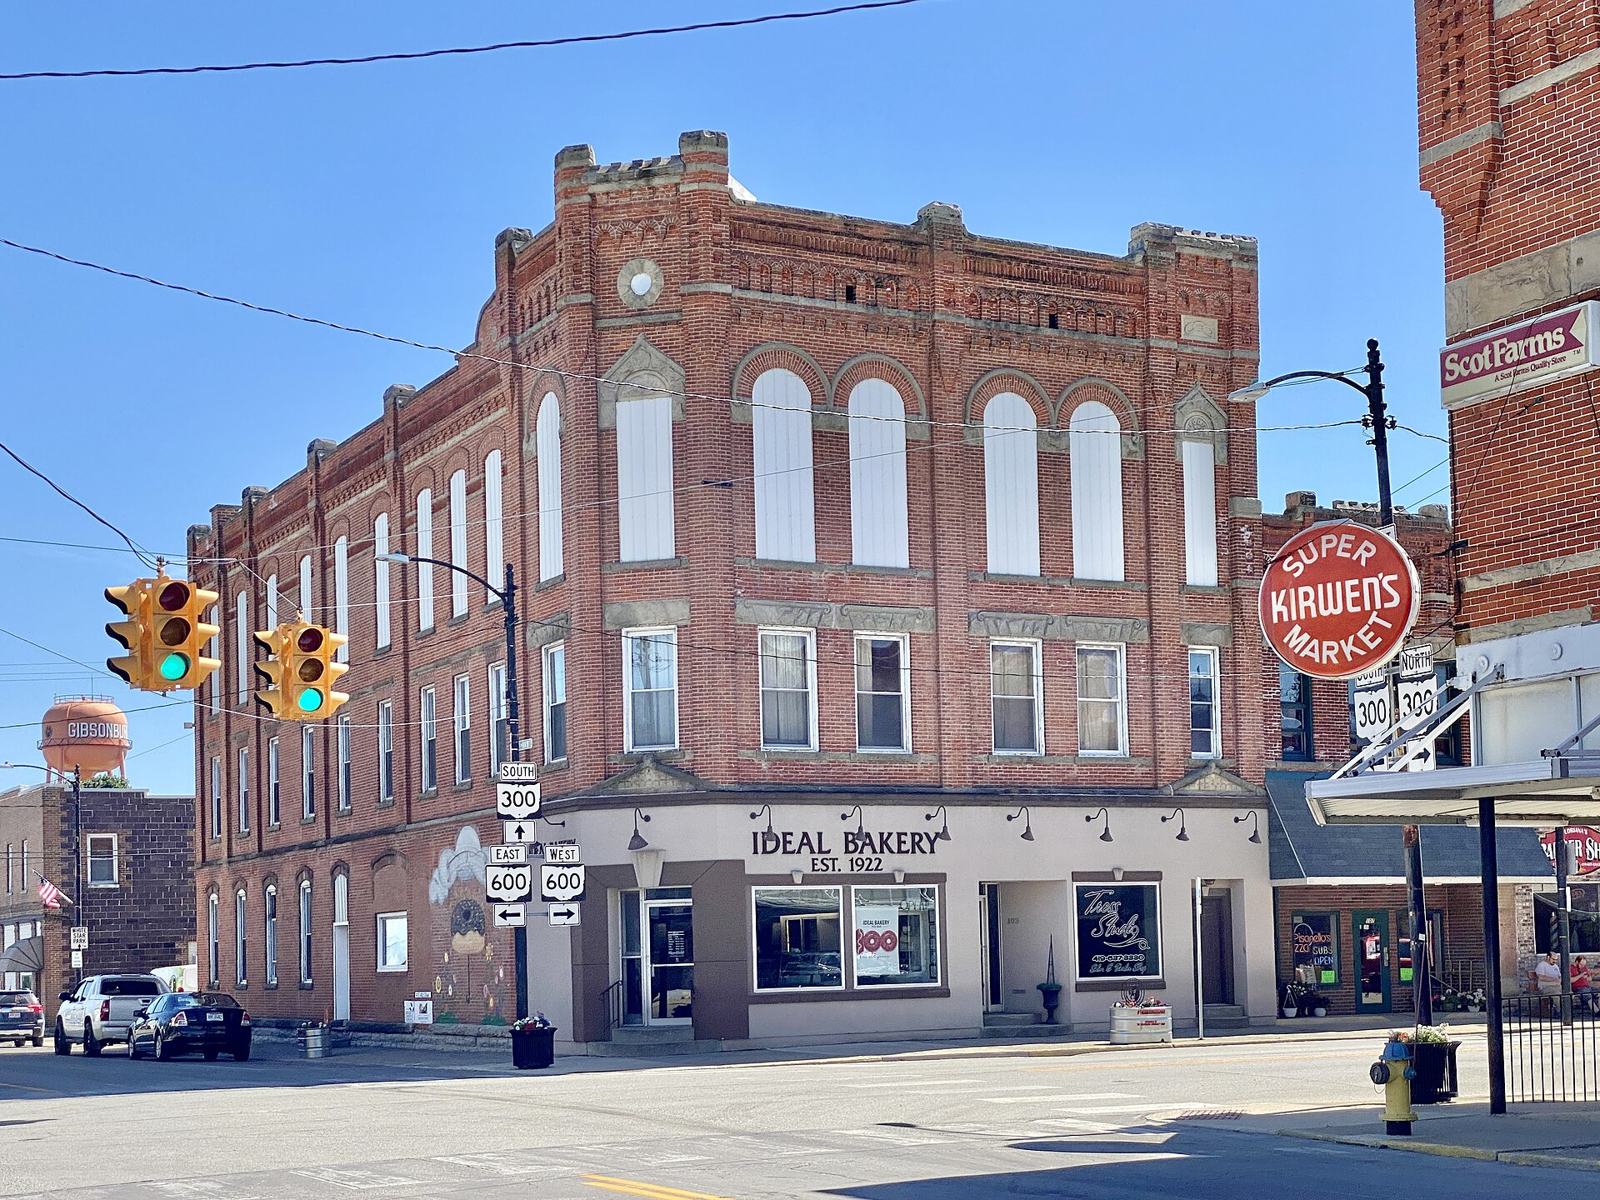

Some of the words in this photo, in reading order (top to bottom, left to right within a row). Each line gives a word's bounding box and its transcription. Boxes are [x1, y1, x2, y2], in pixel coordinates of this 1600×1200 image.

[1500, 372, 1513, 381] Scot
[1513, 367, 1530, 377] Farms
[1530, 359, 1552, 372] Quality
[1551, 356, 1567, 365] Store
[1282, 533, 1377, 578] SUPER
[1271, 572, 1400, 623] KIRWEN'S
[1283, 611, 1392, 665] MARKET
[1401, 650, 1431, 672] NORTH
[1402, 688, 1434, 718] 300
[1358, 698, 1387, 728] 300
[502, 765, 534, 777] SOUTH
[501, 790, 536, 808] 300
[752, 831, 832, 855] IDEAL
[843, 831, 941, 855] BAKERY
[496, 848, 520, 860] EAST
[549, 848, 576, 860] WEST
[811, 857, 842, 873] EST.
[849, 857, 884, 872] 1922
[491, 873, 527, 891] 600
[546, 872, 581, 890] 600
[1312, 945, 1333, 955] SUBS
[1314, 955, 1334, 965] OPEN
